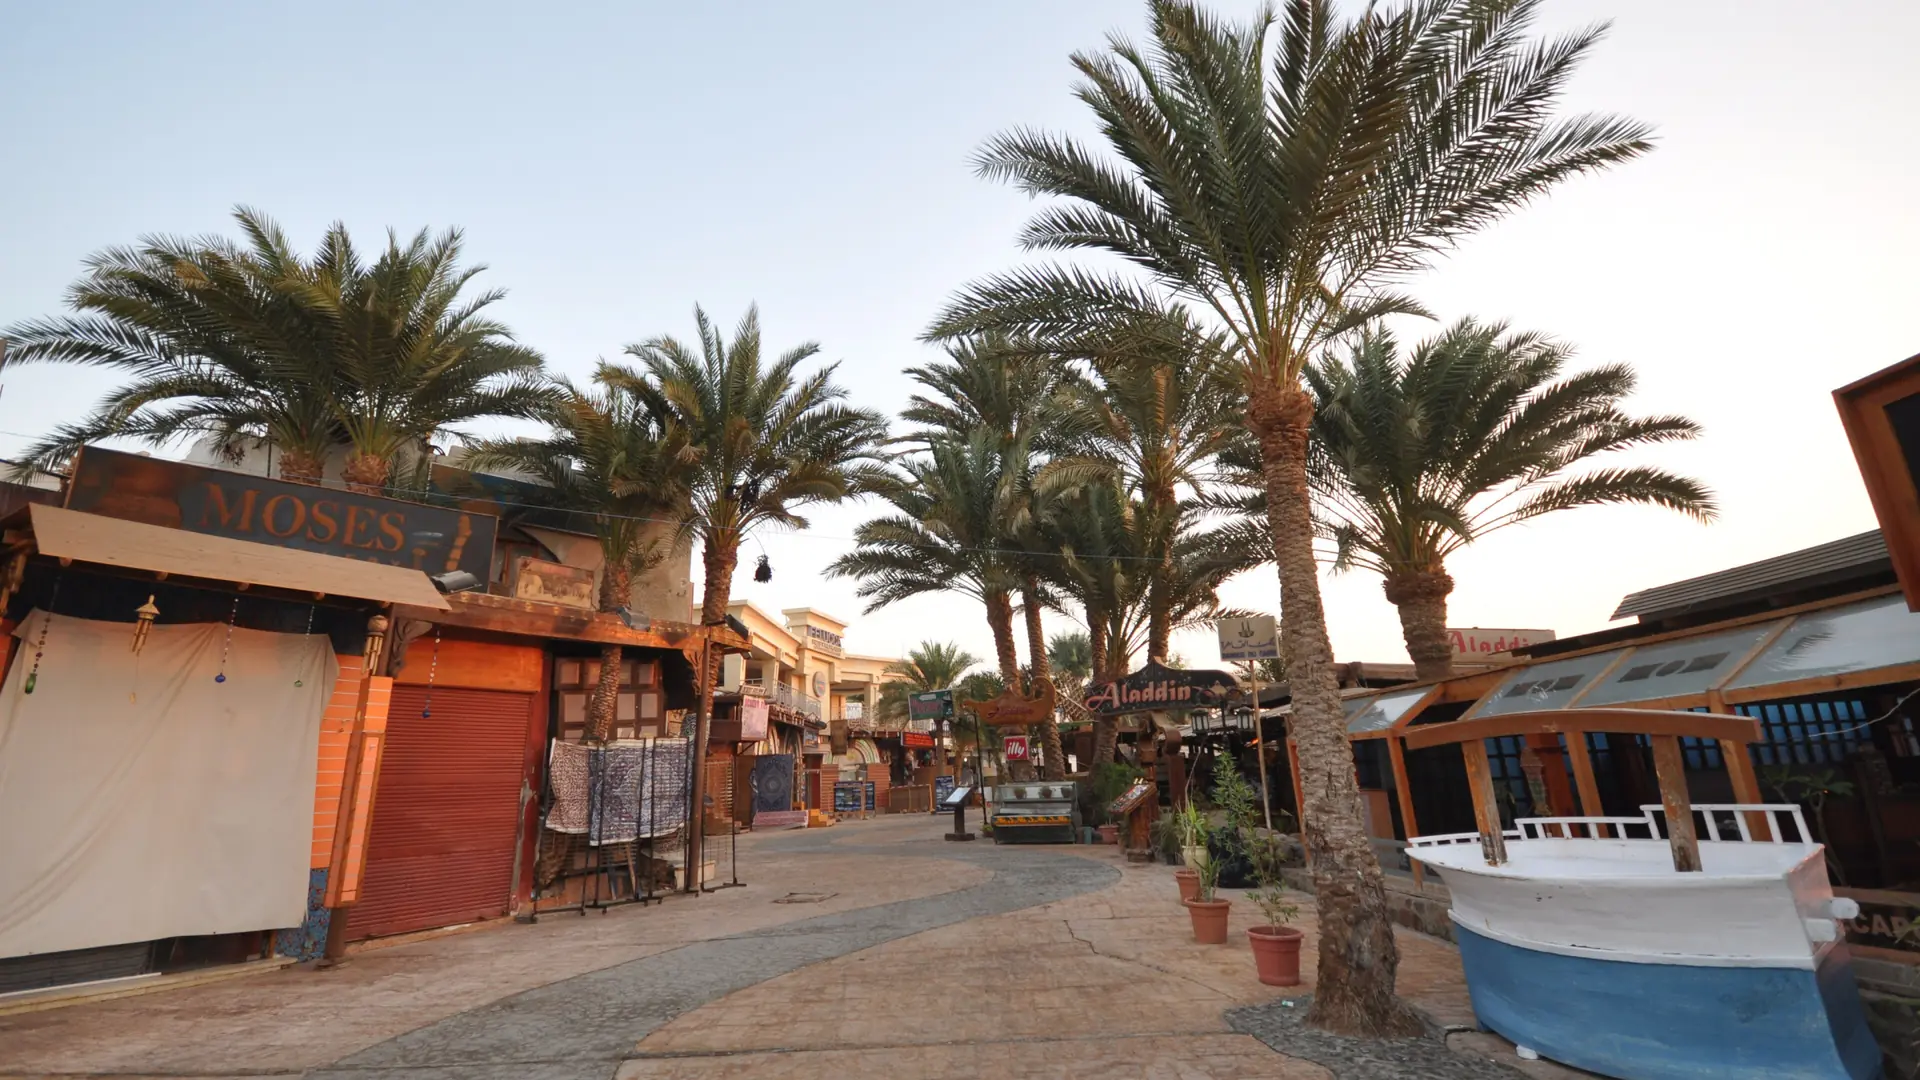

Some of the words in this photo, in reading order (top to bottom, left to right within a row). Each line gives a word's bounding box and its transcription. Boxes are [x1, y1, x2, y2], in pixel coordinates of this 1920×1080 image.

[198, 482, 406, 552] MOSES
[1447, 631, 1530, 653] Aladdi
[1084, 680, 1192, 711] Aladdin
[1006, 741, 1025, 758] illy
